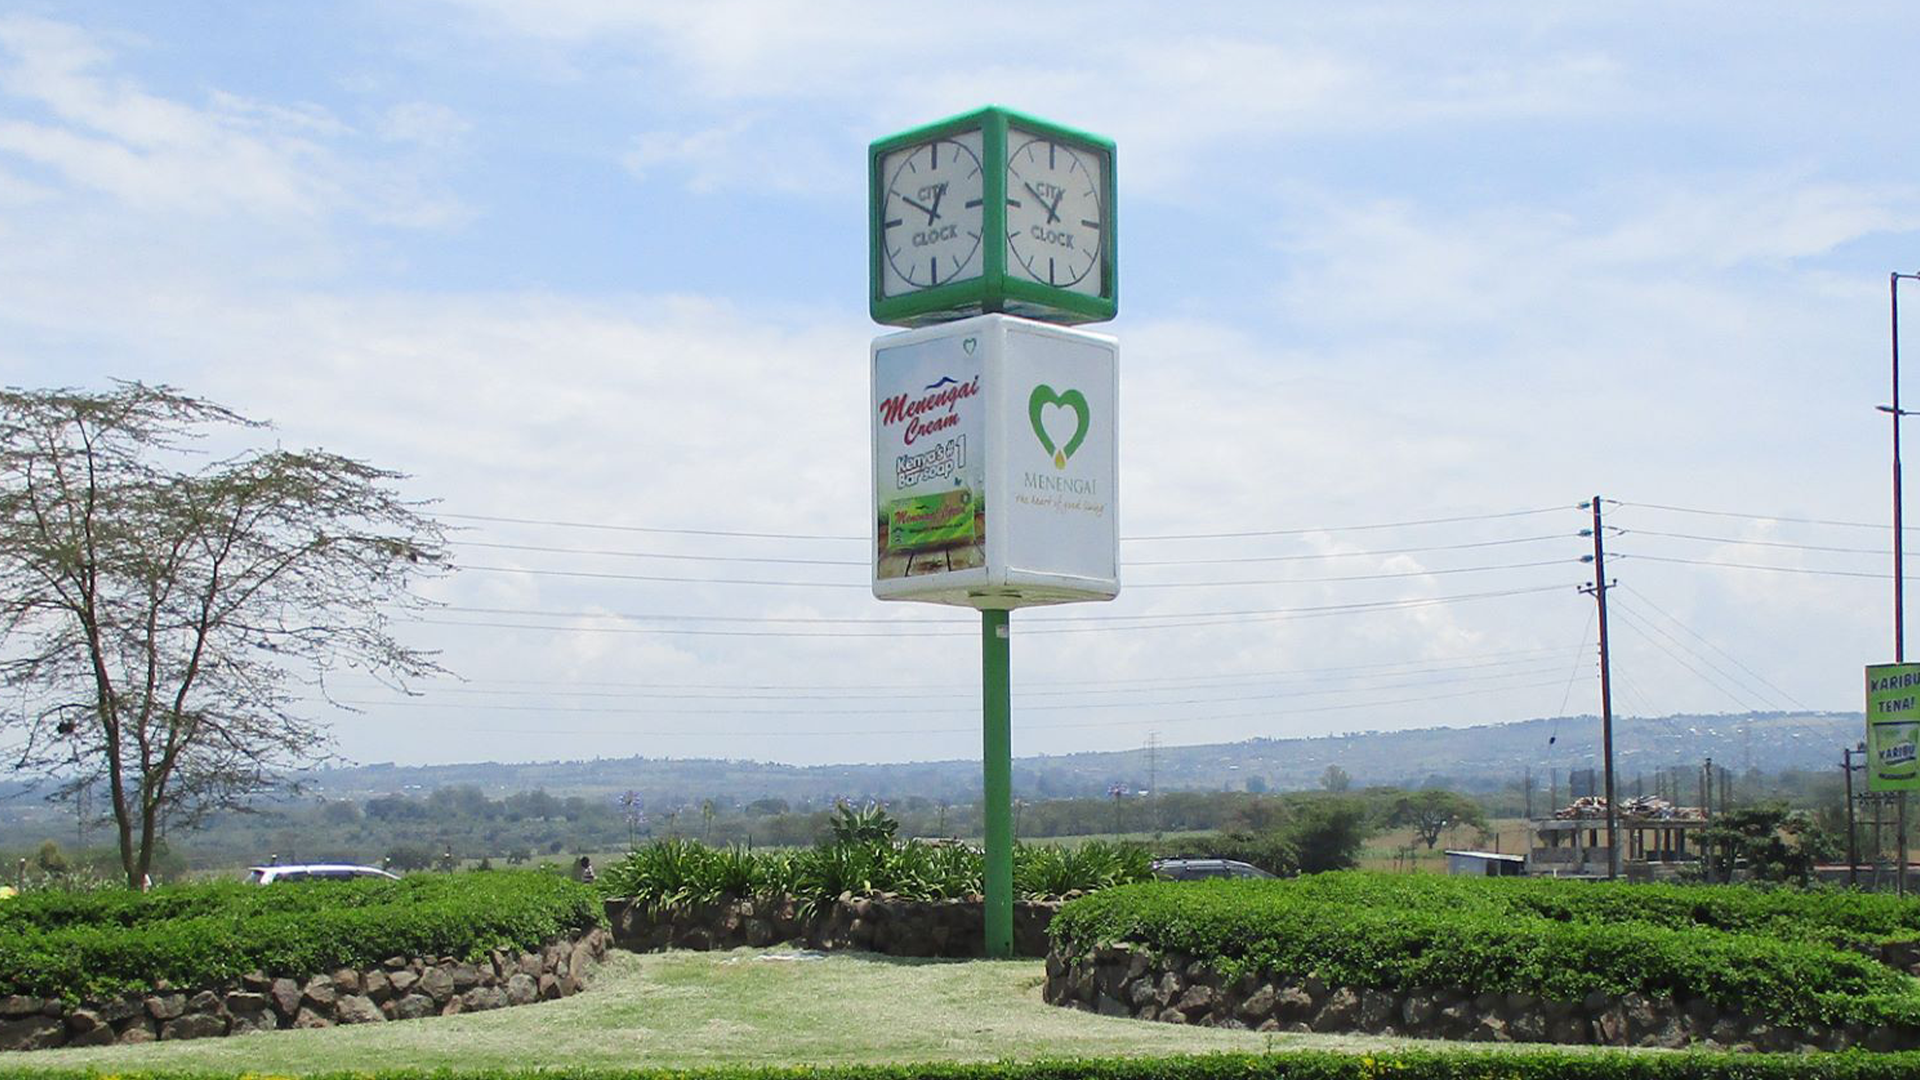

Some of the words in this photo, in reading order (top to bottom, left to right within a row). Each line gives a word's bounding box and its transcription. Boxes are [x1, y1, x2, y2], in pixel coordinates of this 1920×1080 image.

[918, 182, 949, 201] CITY
[1036, 182, 1066, 201] CITY
[912, 224, 958, 248] CLOCK
[1031, 225, 1075, 250] CLOCK
[880, 375, 979, 426] Menengai
[904, 416, 960, 445] Cream
[1024, 472, 1097, 495] MENENGAI
[1871, 672, 1920, 692] KARIBU
[1878, 697, 1915, 713] TENA!
[1878, 744, 1915, 760] KARIBU
